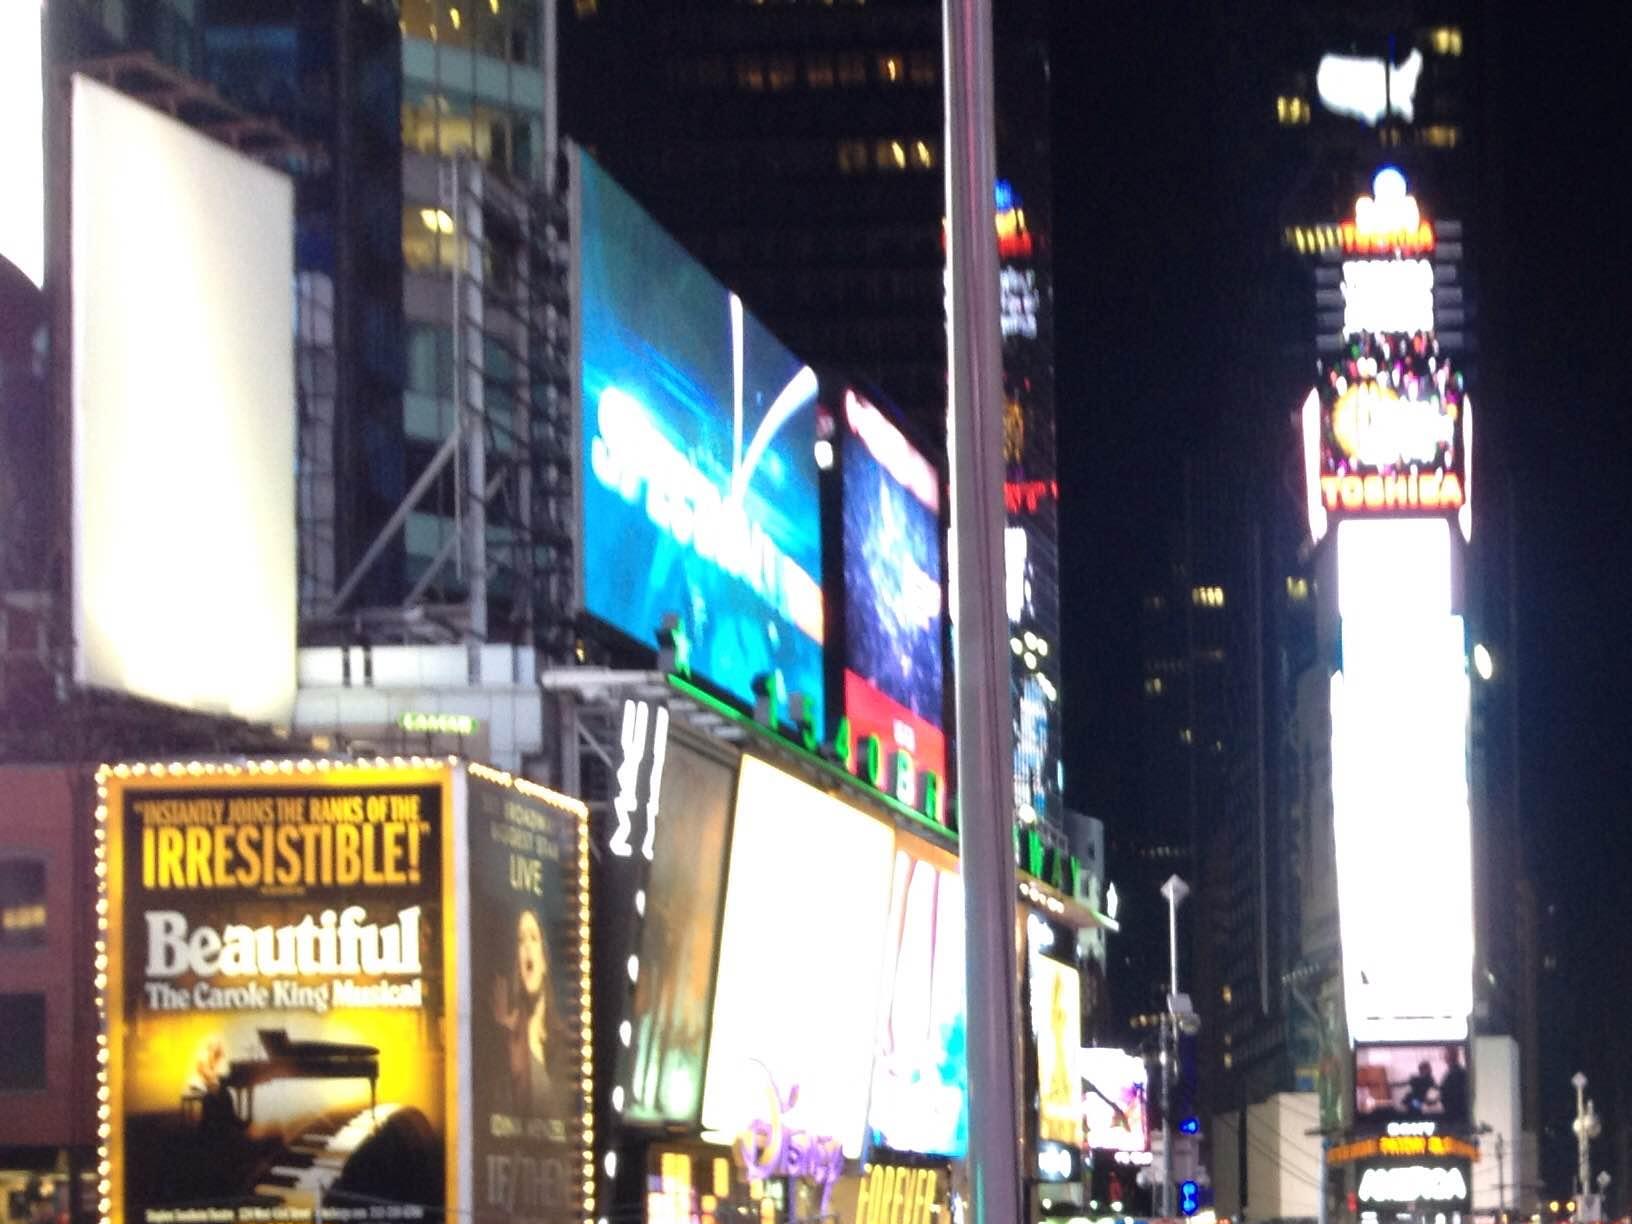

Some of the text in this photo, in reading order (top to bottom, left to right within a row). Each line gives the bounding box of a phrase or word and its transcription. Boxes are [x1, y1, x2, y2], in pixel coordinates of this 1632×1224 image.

[1321, 472, 1464, 512] TOSHIBA
[277, 797, 305, 823] THE
[310, 795, 364, 823] RANKS
[366, 795, 388, 821] OF
[390, 794, 421, 821] THE
[145, 904, 423, 977] Beautiful
[145, 977, 423, 1014] The Carole King Musical
